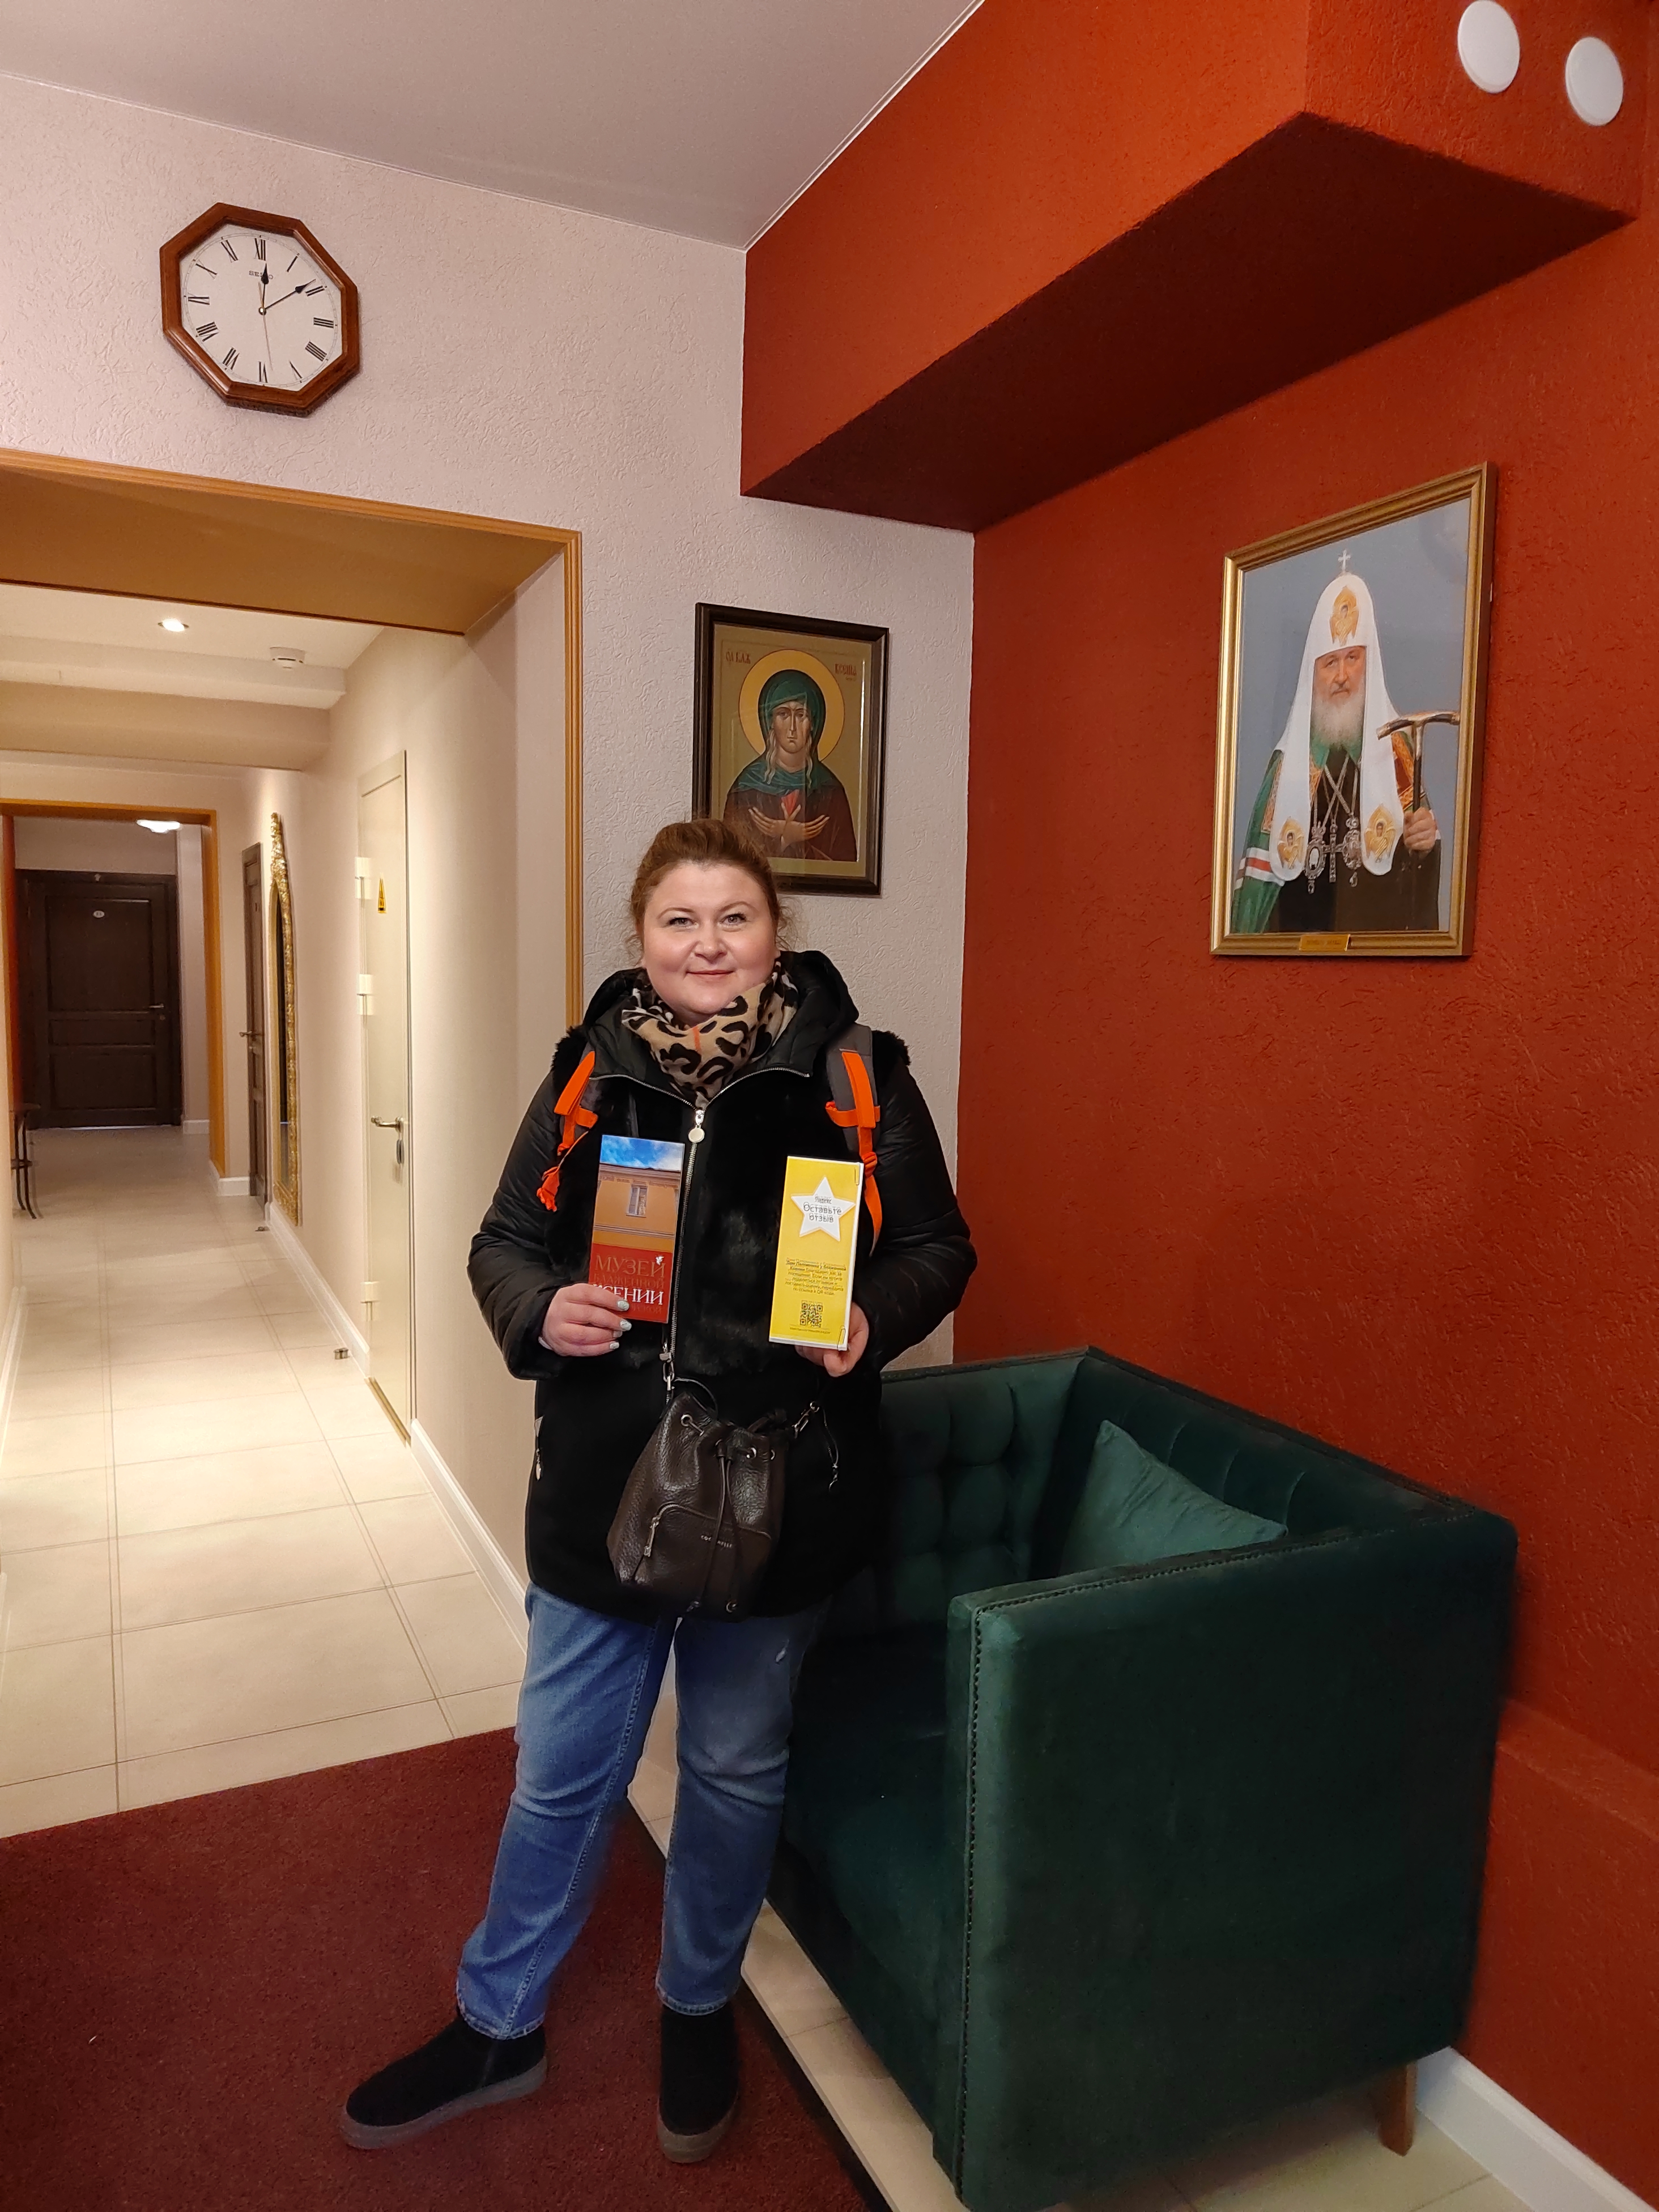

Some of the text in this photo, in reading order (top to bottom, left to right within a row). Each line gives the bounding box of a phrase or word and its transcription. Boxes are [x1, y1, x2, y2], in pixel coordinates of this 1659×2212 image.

[249, 270, 274, 280] SEIO
[803, 1203, 842, 1215] Оставьте
[809, 1214, 834, 1223] отзыв
[594, 1254, 666, 1278] МУЗЕЙ
[593, 1284, 664, 1305] ЕНИИ
[701, 1535, 732, 1548] COCNELLE
